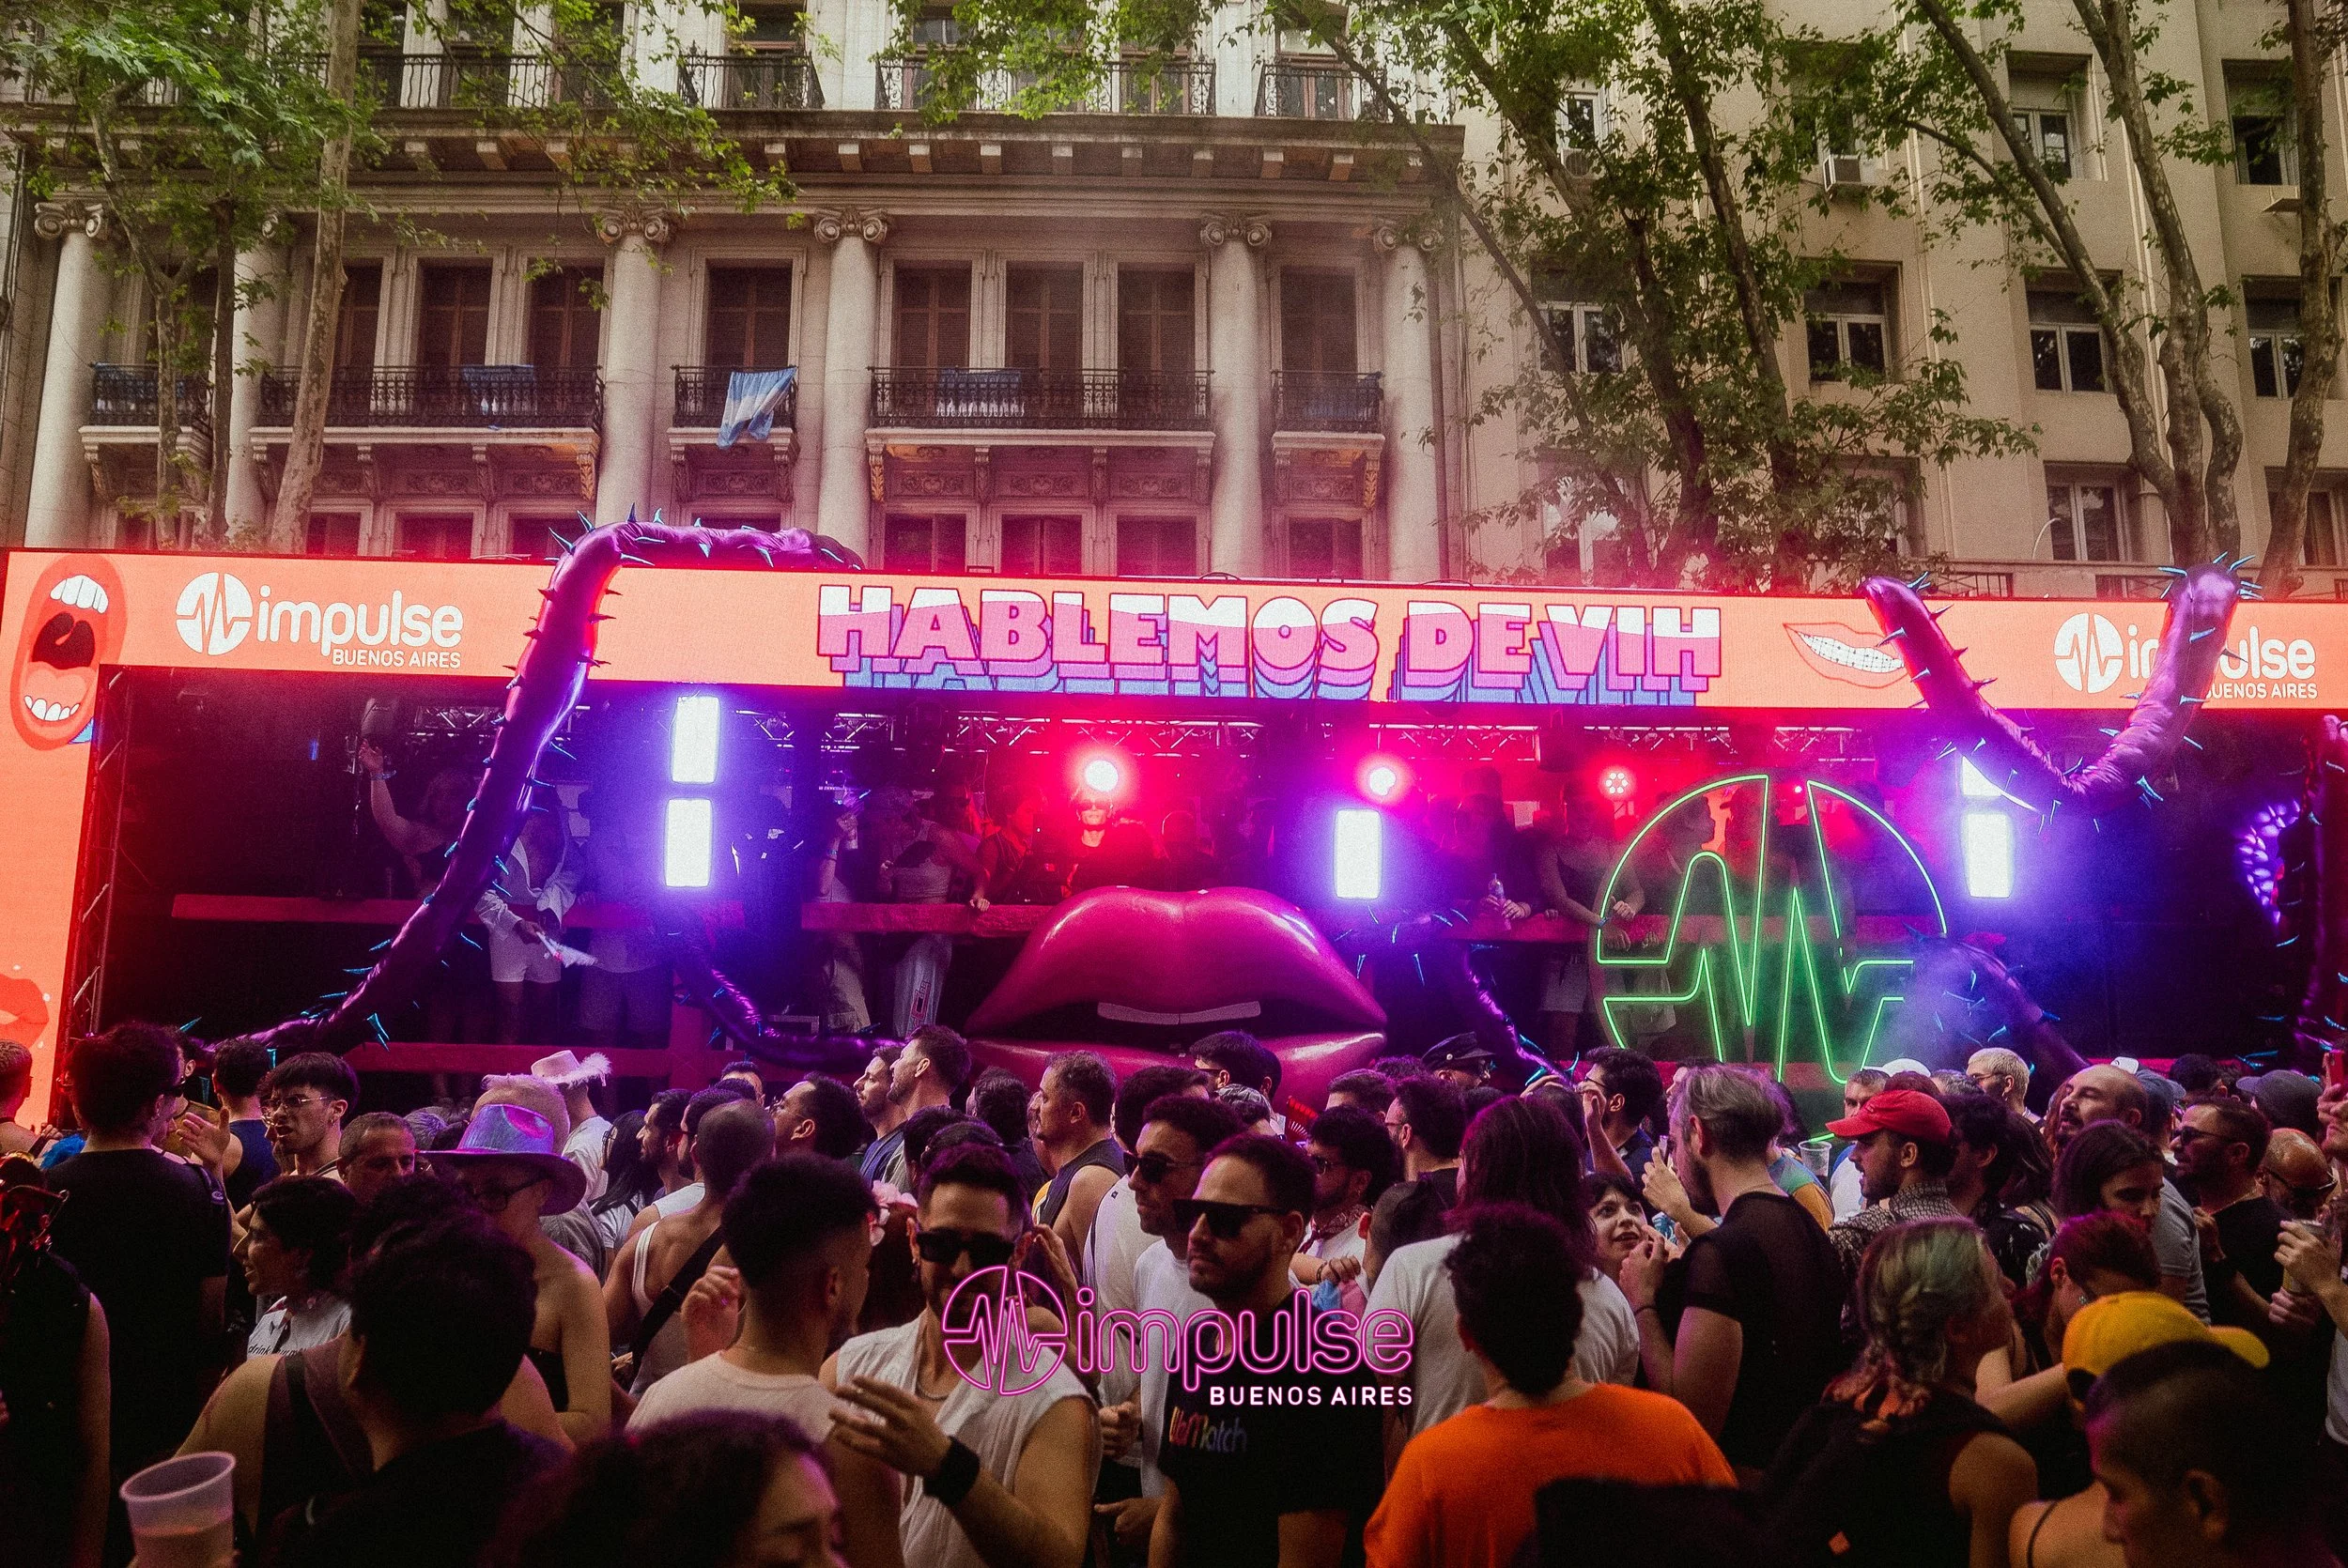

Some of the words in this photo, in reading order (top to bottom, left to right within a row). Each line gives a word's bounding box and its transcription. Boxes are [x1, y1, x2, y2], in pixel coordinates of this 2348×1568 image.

[256, 584, 464, 657] impulse
[817, 584, 1380, 674] HABLEMOS
[1406, 600, 1533, 678] DE
[1545, 604, 1722, 680] VIH
[332, 648, 405, 668] BUENOS
[408, 651, 462, 669] AIRES
[2126, 623, 2317, 680] iulse
[2206, 682, 2267, 699] UENOS
[2271, 683, 2318, 699] AIRES
